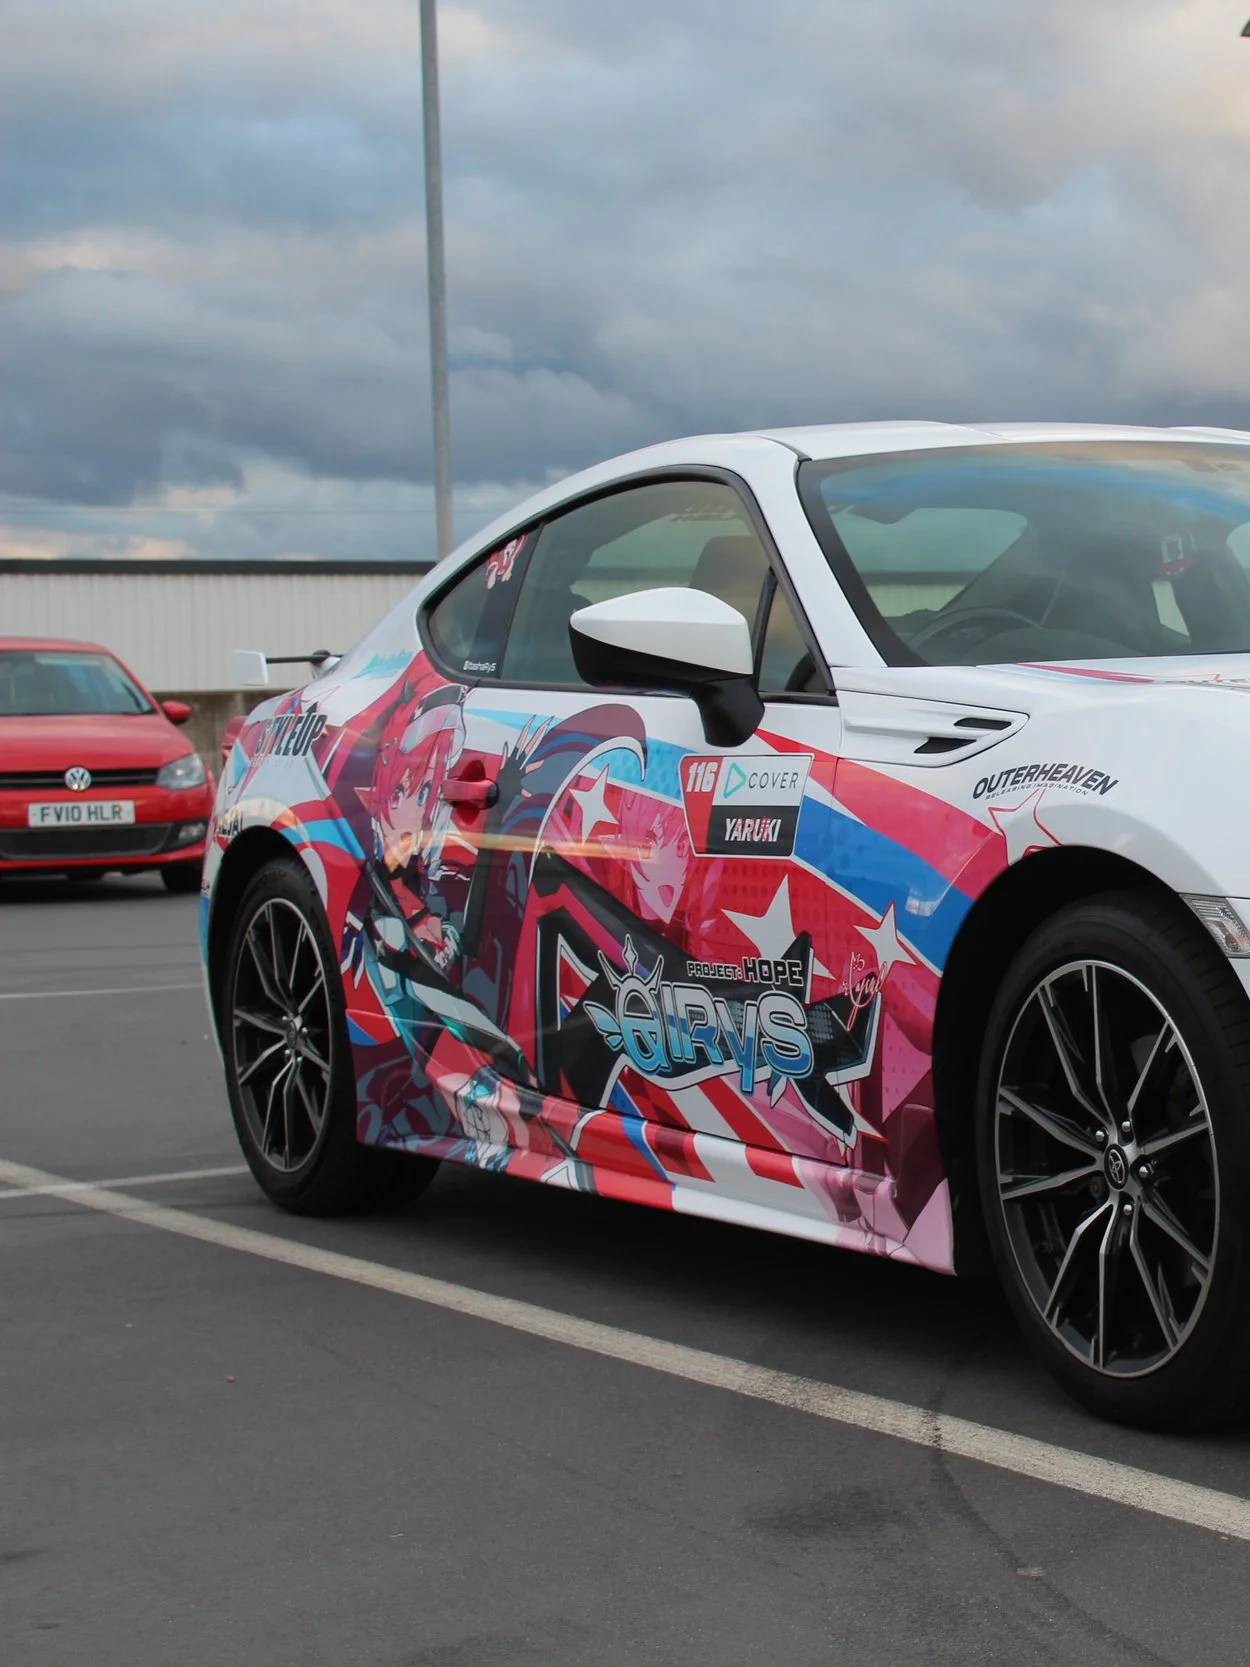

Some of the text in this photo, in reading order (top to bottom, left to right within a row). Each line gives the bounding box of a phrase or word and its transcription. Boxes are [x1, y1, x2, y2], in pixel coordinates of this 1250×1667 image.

[686, 761, 719, 793] 116
[748, 772, 799, 789] COVER
[972, 763, 1119, 800] OUTERHEAVEN
[1033, 782, 1089, 796] IMAGINATION
[87, 804, 122, 821] HLR
[725, 818, 782, 842] YARUKI
[686, 956, 804, 987] PROJECT: HOPE
